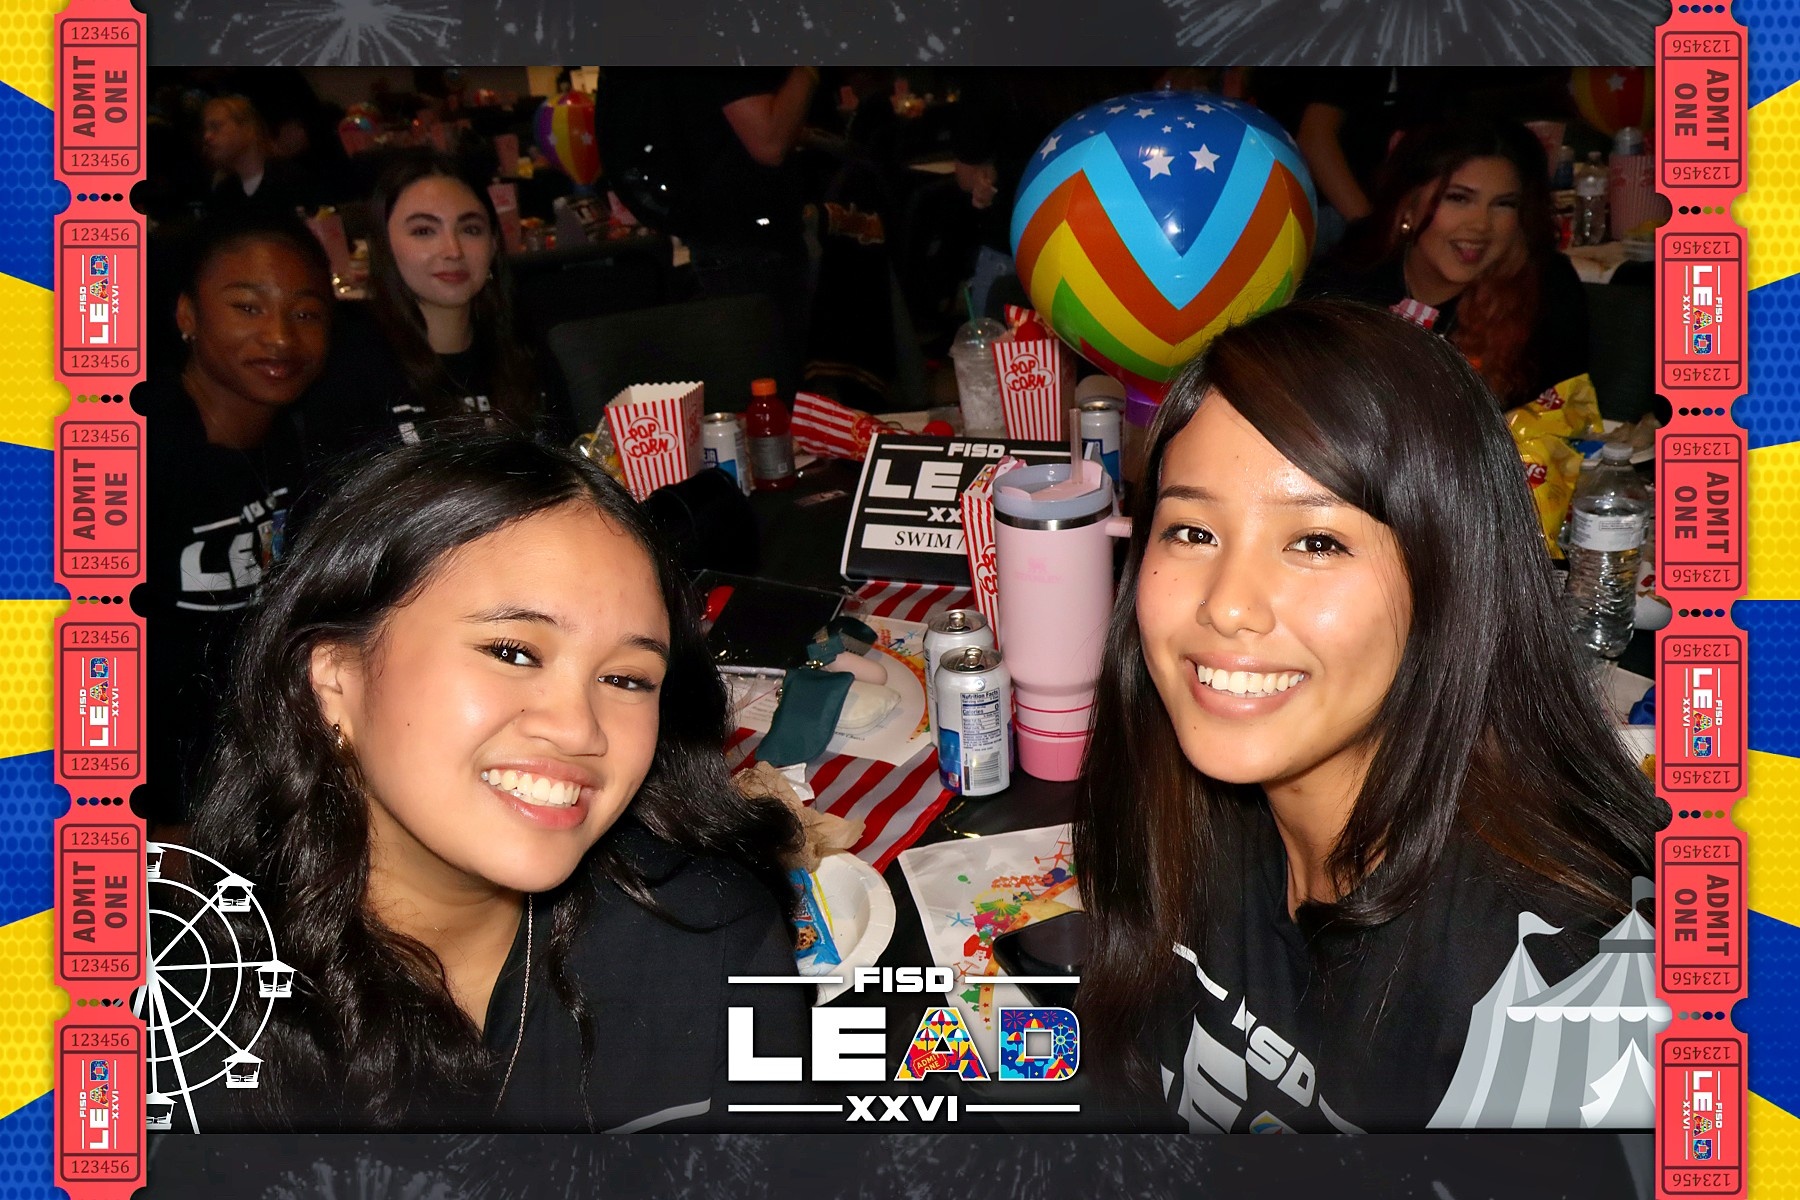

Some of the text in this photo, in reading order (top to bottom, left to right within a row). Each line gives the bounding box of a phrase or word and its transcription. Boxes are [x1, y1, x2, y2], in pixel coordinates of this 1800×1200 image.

[1010, 360, 1036, 376] POP
[1010, 374, 1046, 392] CORN
[628, 423, 657, 442] POP
[631, 438, 669, 458] CORN
[947, 443, 1005, 459] FISD
[927, 506, 962, 523] XX
[894, 530, 951, 549] SWIM
